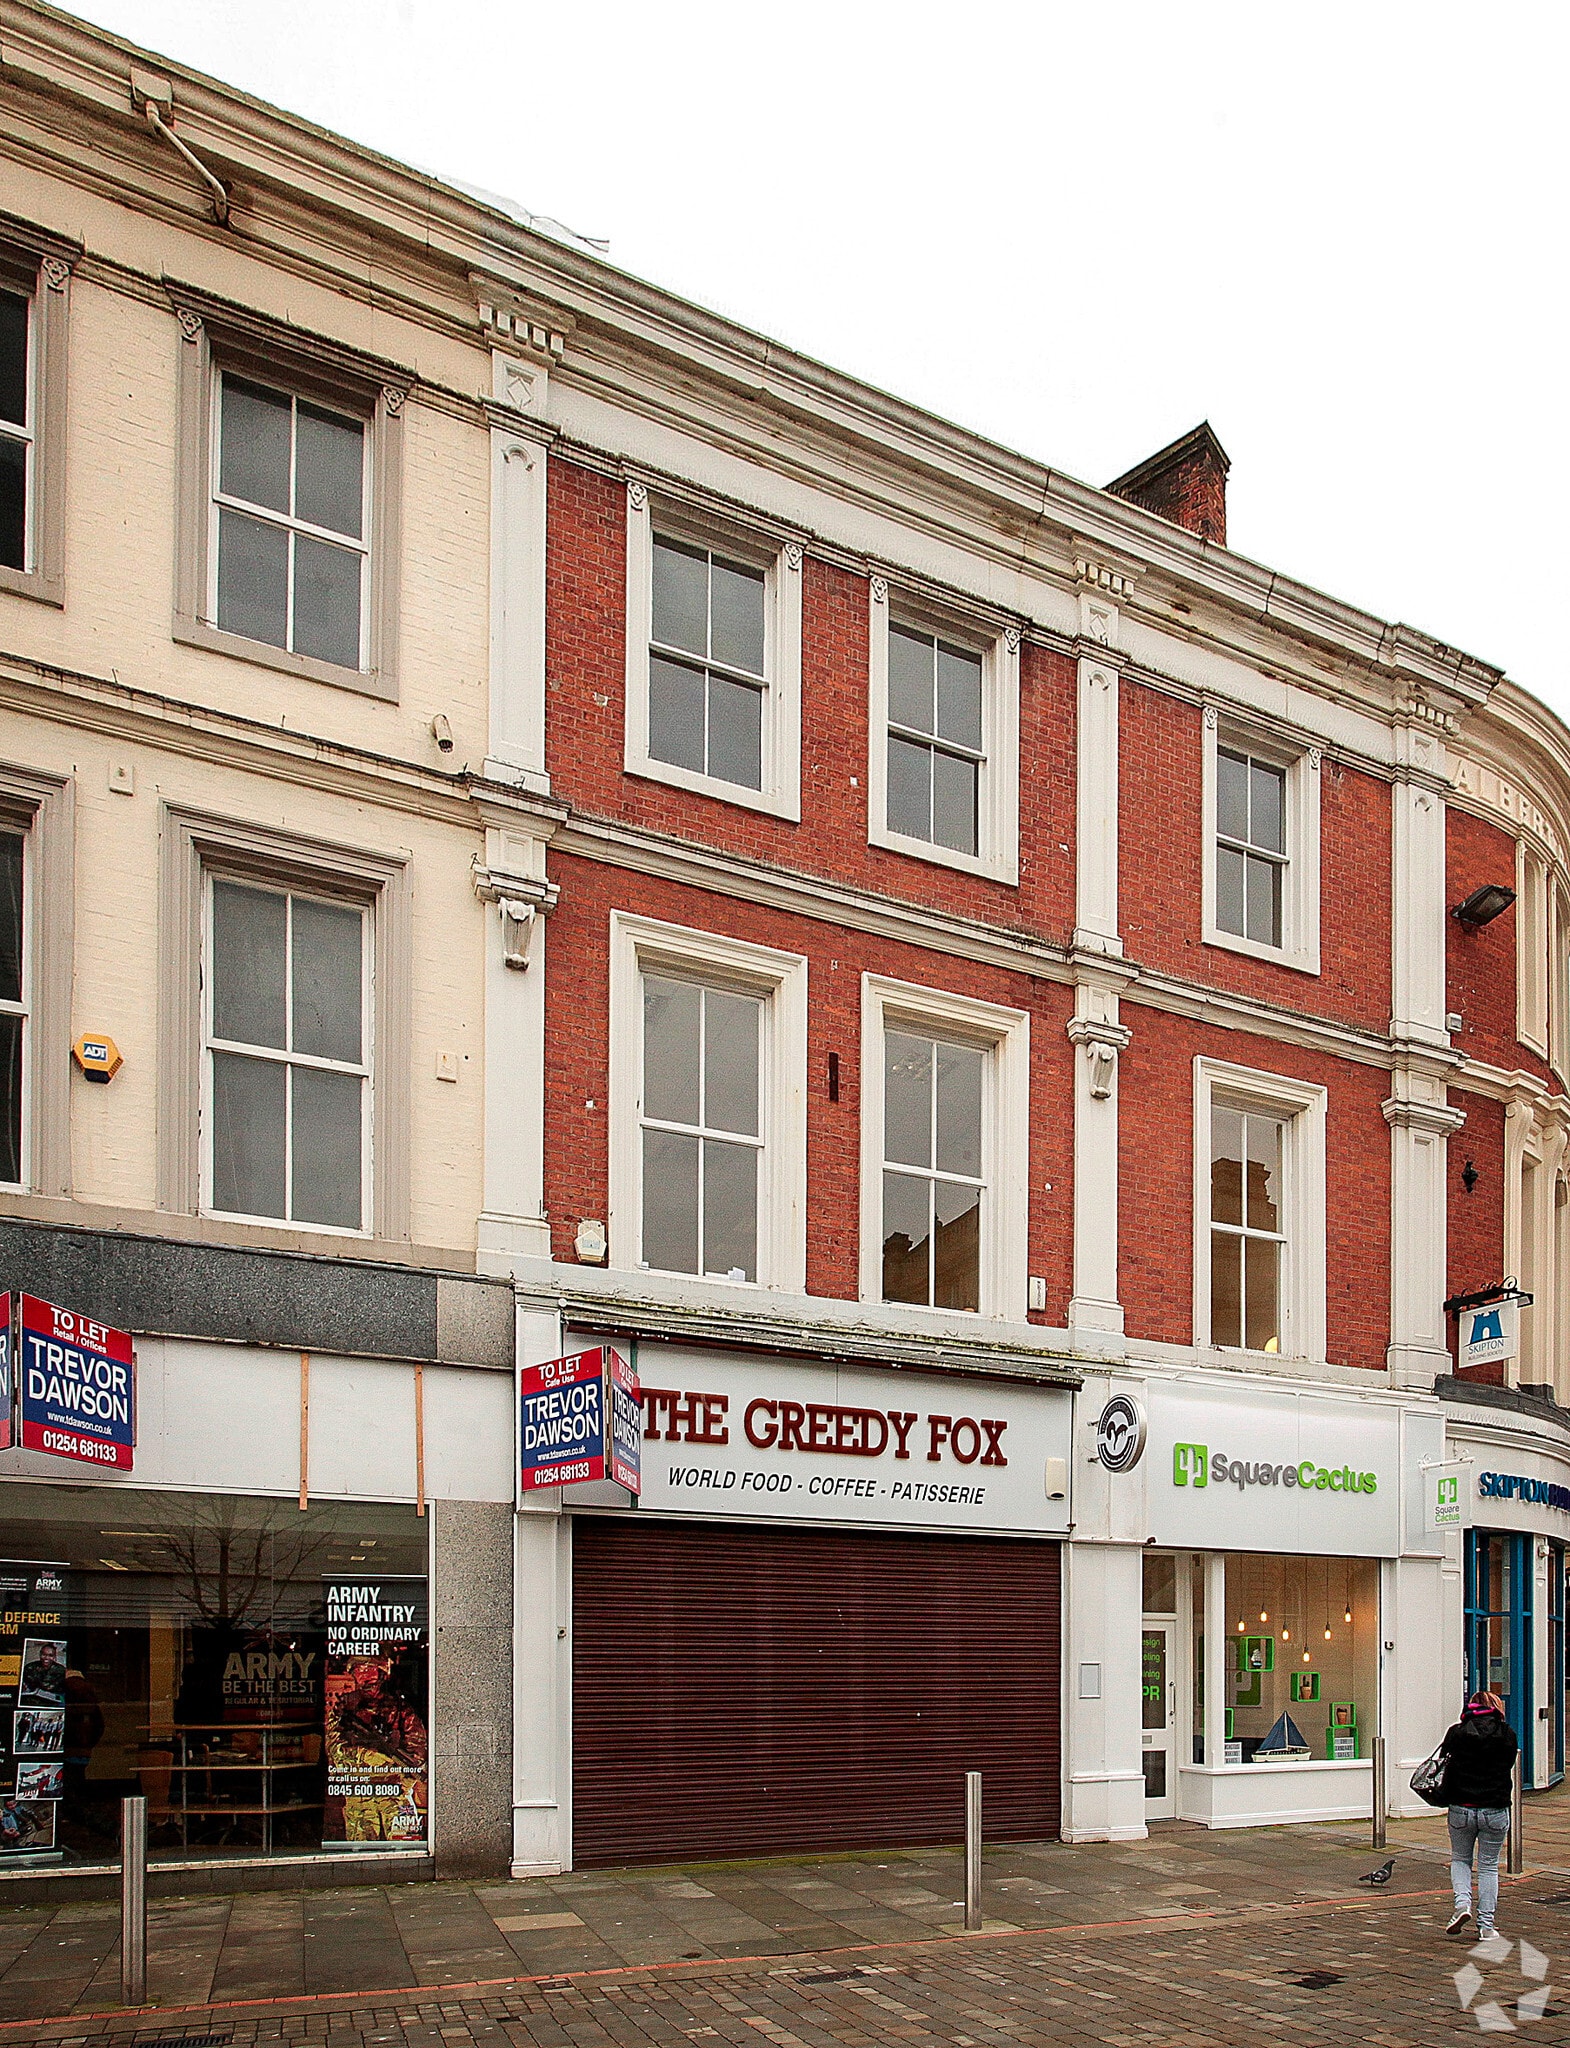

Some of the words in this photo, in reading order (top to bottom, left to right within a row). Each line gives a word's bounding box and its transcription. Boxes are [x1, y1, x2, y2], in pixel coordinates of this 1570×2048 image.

[84, 1045, 107, 1058] ADT
[51, 1307, 74, 1330] TO
[80, 1319, 109, 1343] LET
[53, 1327, 74, 1342] Retail
[81, 1338, 107, 1354] Offices
[1468, 1339, 1504, 1354] SKIPTON
[28, 1336, 127, 1395] TREVOR
[538, 1364, 555, 1380] TO
[559, 1356, 582, 1375] LET
[562, 1375, 575, 1384] Use
[29, 1368, 128, 1424] DAWSON
[525, 1383, 598, 1423] TREVOR
[613, 1384, 639, 1430] TREVOR
[525, 1410, 600, 1450] DAWSON
[613, 1411, 639, 1455] DAWSON
[640, 1387, 729, 1445] THE
[744, 1398, 918, 1459] GREEDY
[927, 1414, 1008, 1466] FOX
[43, 1430, 78, 1453] 01254
[79, 1440, 117, 1462] 681133
[534, 1465, 559, 1485] 01254
[560, 1462, 590, 1480] 681133
[668, 1467, 736, 1489] WORLD
[741, 1472, 793, 1492] FOOD
[809, 1477, 877, 1498] COFFEE
[891, 1482, 986, 1505] PATISSERIE
[1480, 1471, 1549, 1504] SKIPTON
[1435, 1505, 1460, 1516] Square
[1435, 1513, 1460, 1523] Cactus
[36, 1578, 62, 1587] ARMY
[326, 1586, 381, 1604] ARMY
[5, 1612, 61, 1625] DEFENCE
[327, 1605, 416, 1623] INFANTRY
[327, 1627, 347, 1640] NO
[351, 1627, 422, 1641] ORDINARY
[328, 1642, 380, 1656] CAREER
[223, 1652, 316, 1679] ARMY
[222, 1680, 242, 1694] BE
[245, 1680, 275, 1693] THE
[280, 1680, 316, 1693] BEST
[225, 1697, 259, 1705] REGULAR
[328, 1765, 349, 1773] Come
[350, 1765, 358, 1773] in
[359, 1765, 373, 1773] and
[374, 1765, 389, 1773] find
[336, 1774, 350, 1782] call
[328, 1784, 352, 1796] 0845
[354, 1784, 373, 1796] 600
[375, 1784, 400, 1796] 8080
[392, 1815, 423, 1826] ARMY
